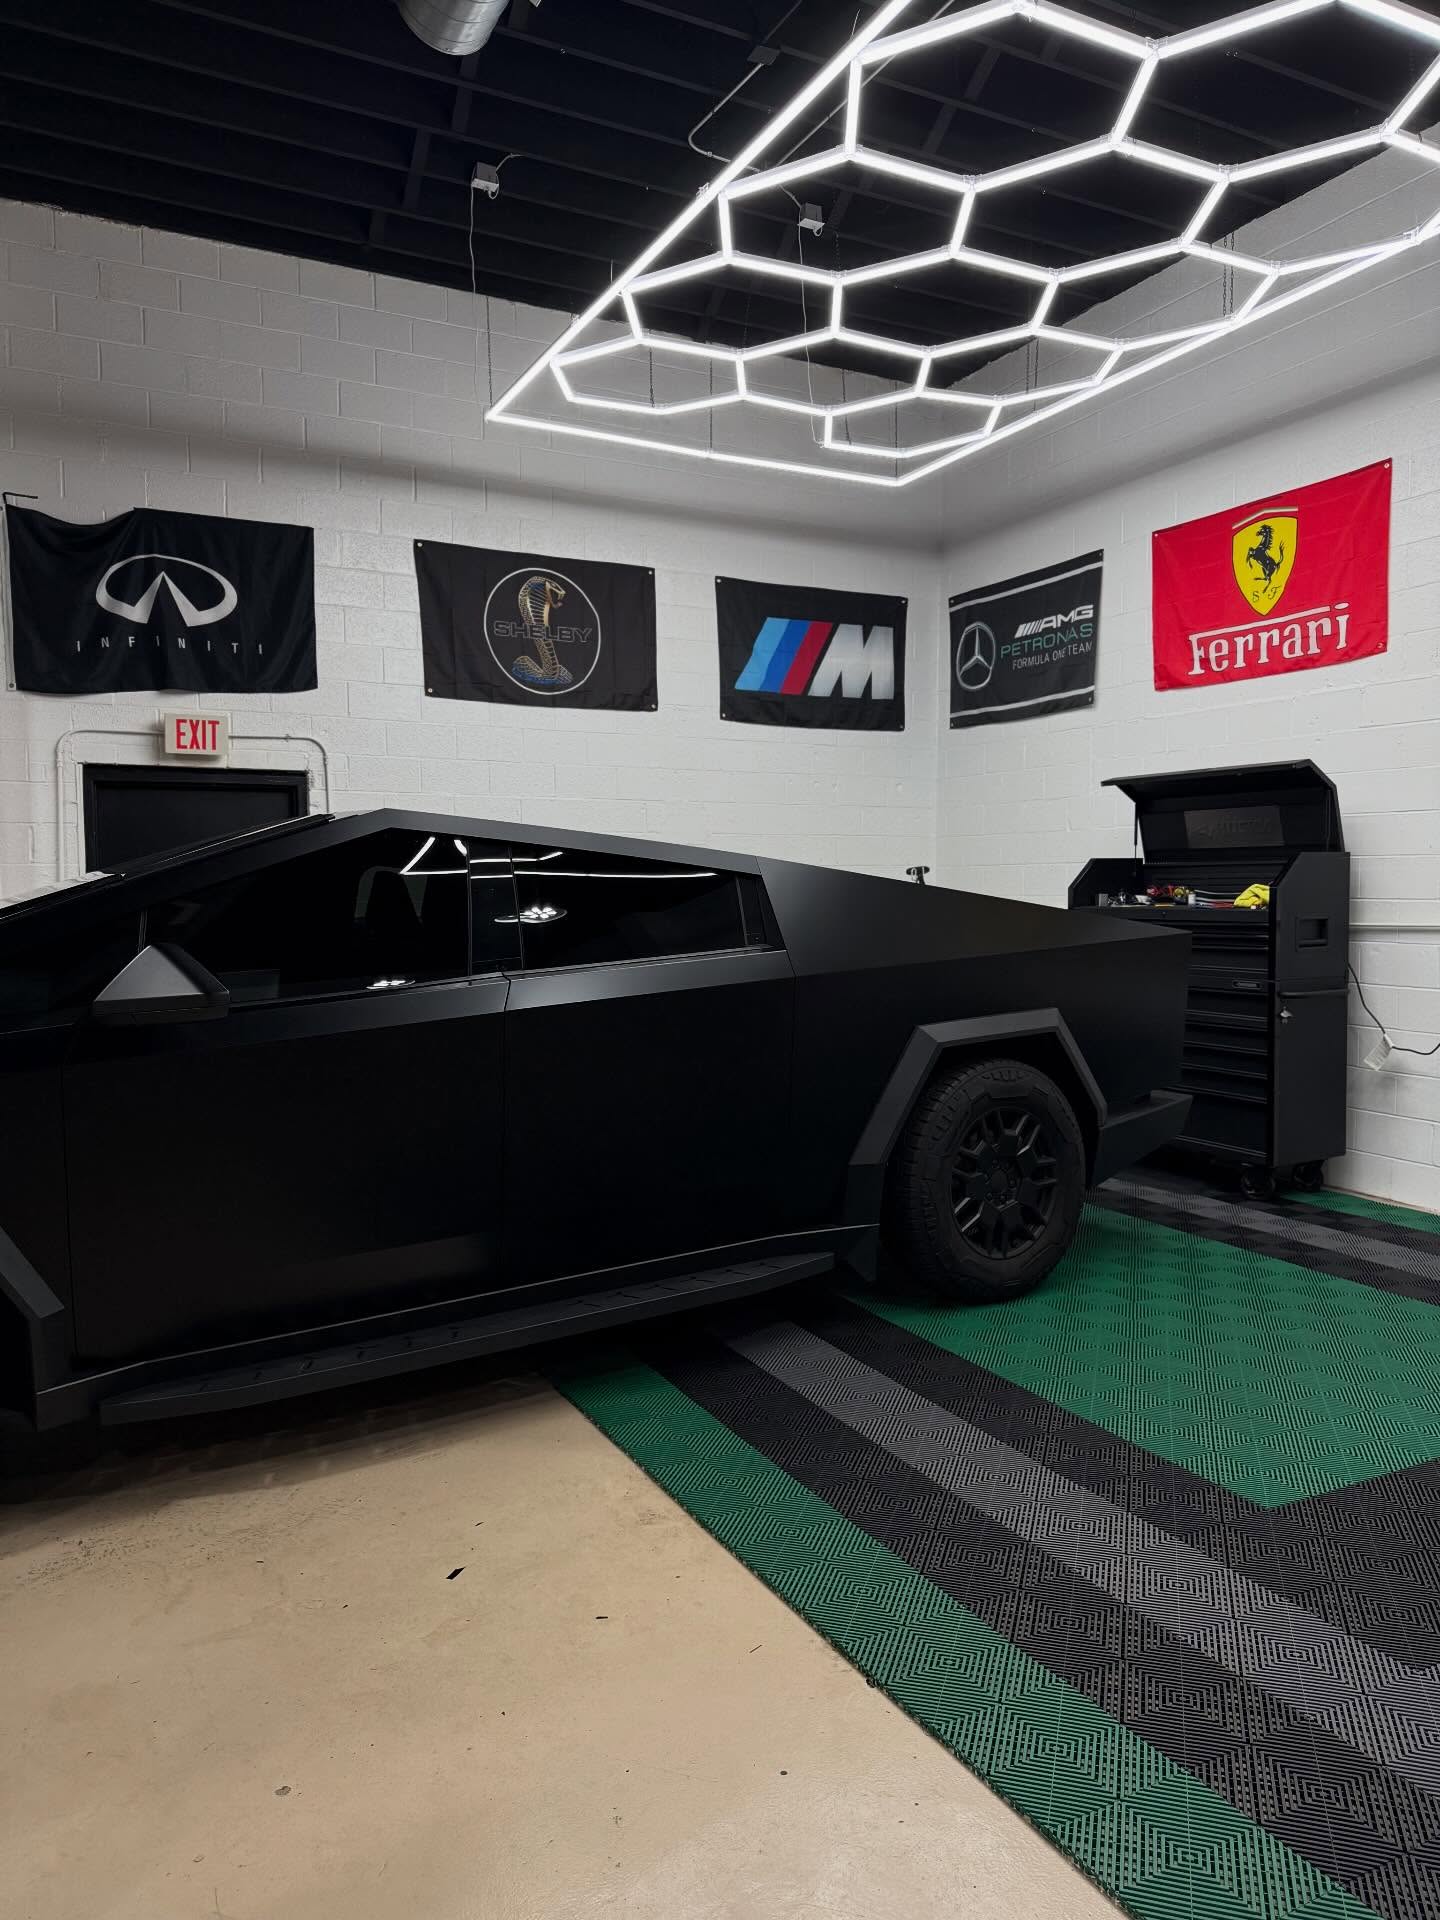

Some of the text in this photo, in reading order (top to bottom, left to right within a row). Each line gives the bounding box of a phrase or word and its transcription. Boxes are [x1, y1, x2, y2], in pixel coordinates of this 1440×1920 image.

[493, 620, 592, 643] SHELBY
[1039, 604, 1094, 632] AMG
[76, 635, 263, 655] INFINITI
[1000, 623, 1093, 659] PETRONAS
[1187, 602, 1350, 676] Ferrari
[1012, 652, 1050, 671] FORMULA
[175, 718, 220, 751] EXIT
